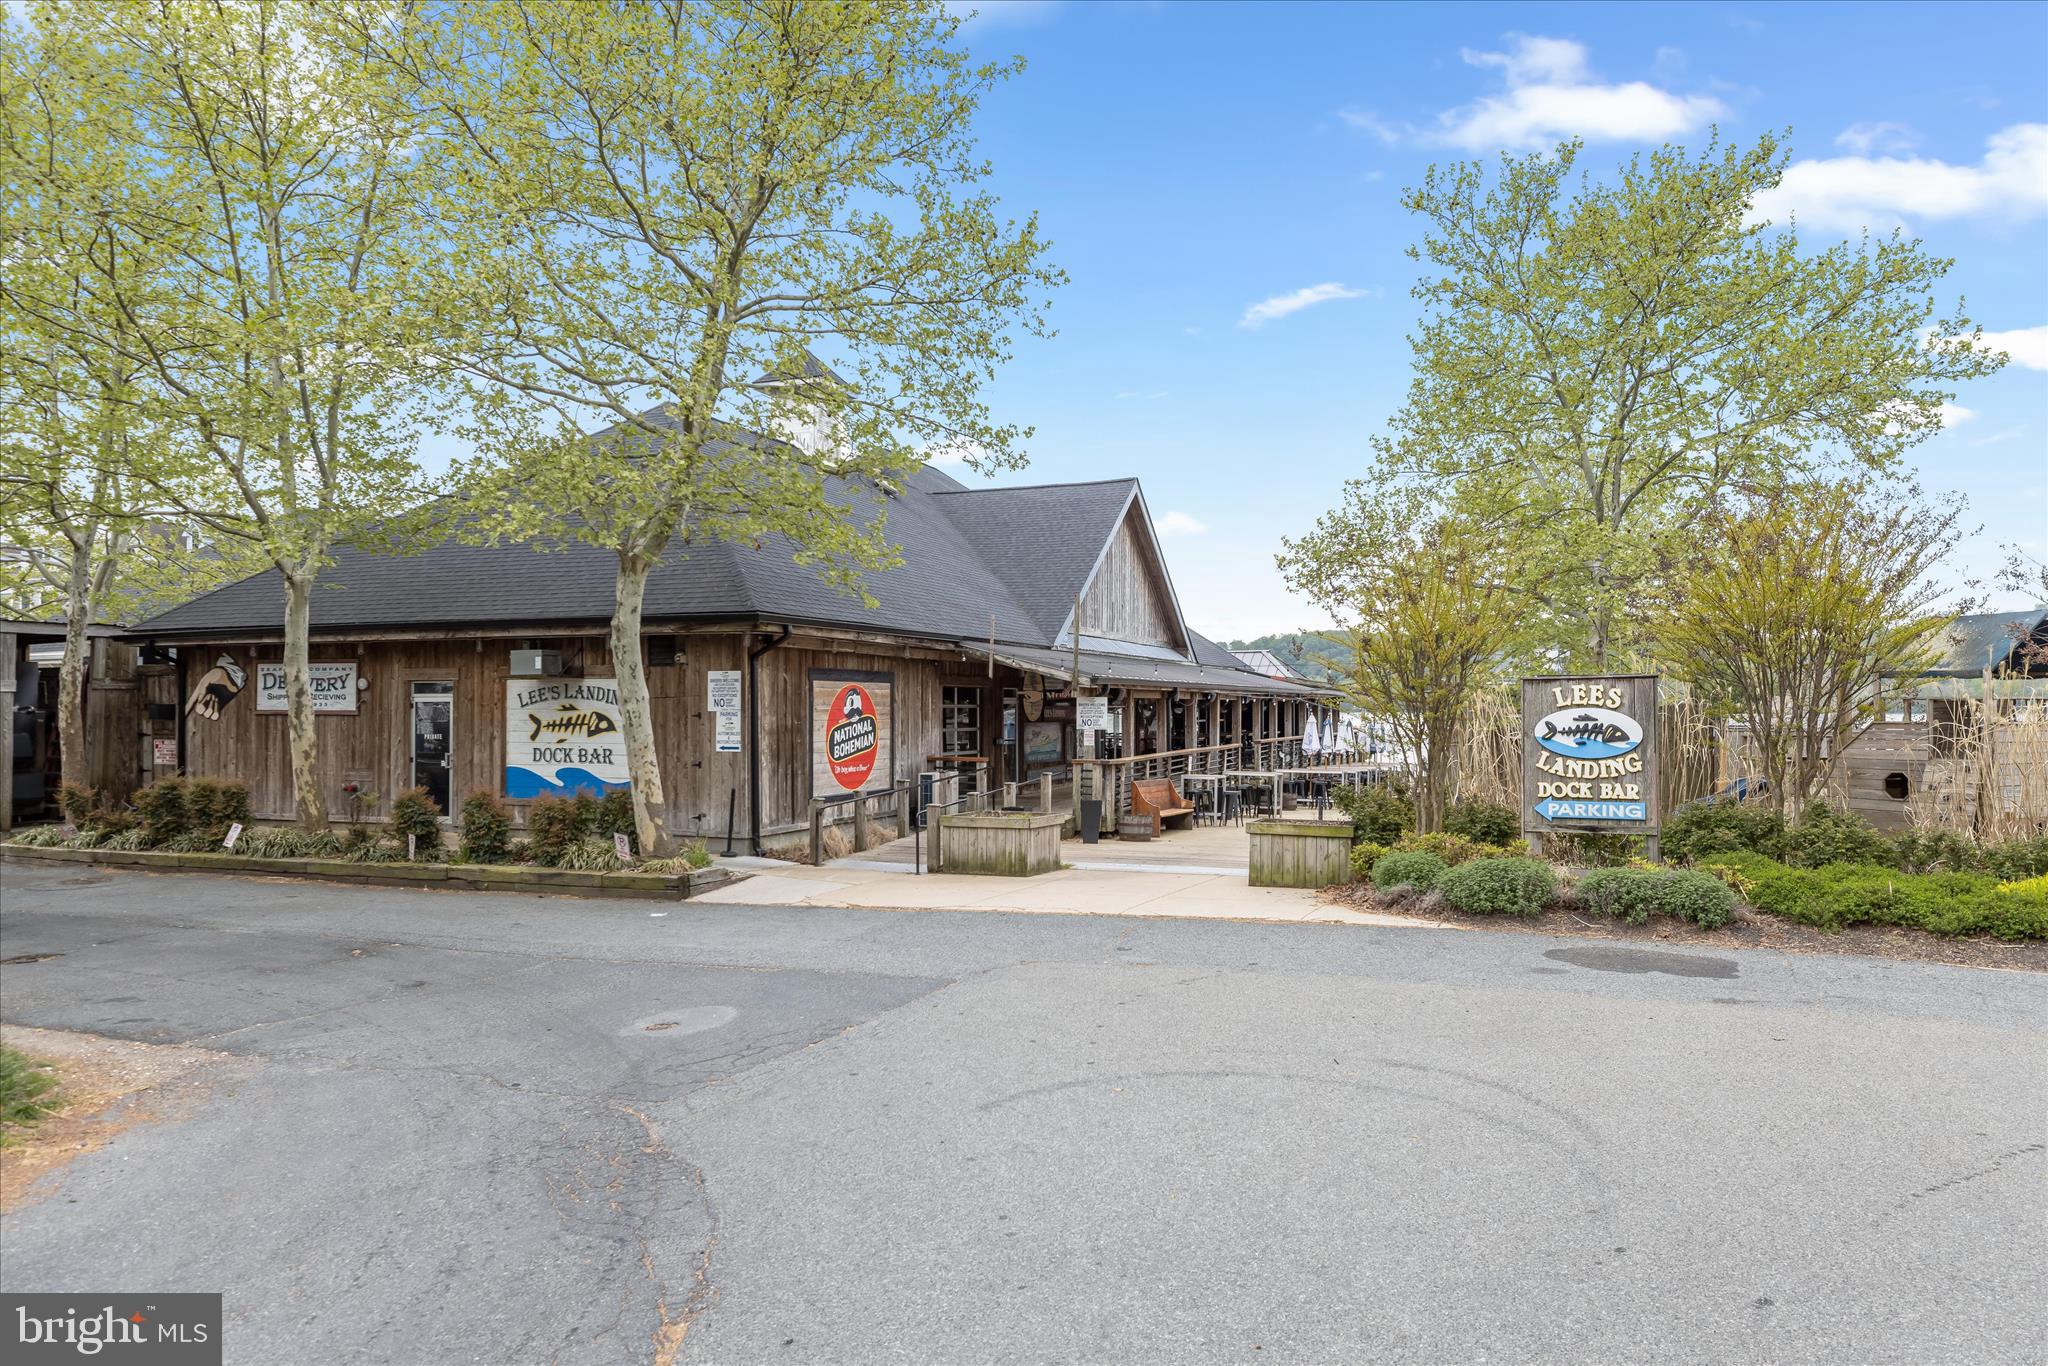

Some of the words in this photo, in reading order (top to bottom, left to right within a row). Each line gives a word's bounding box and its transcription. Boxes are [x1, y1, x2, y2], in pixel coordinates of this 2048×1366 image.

[267, 693, 288, 701] SHIPP
[517, 686, 561, 708] LEE'S
[564, 683, 618, 706] LANDIN
[713, 698, 725, 708] NO
[1552, 684, 1622, 709] LEES
[833, 719, 873, 744] NATIONAL
[1081, 718, 1093, 727] NO
[833, 732, 874, 759] BOHEMIAN
[533, 747, 574, 764] DOCK
[577, 748, 614, 765] BAR
[1536, 750, 1643, 779] LANDING
[1537, 781, 1593, 798] DOCK
[1600, 783, 1640, 800] BAR
[1548, 803, 1642, 817] PARKING
